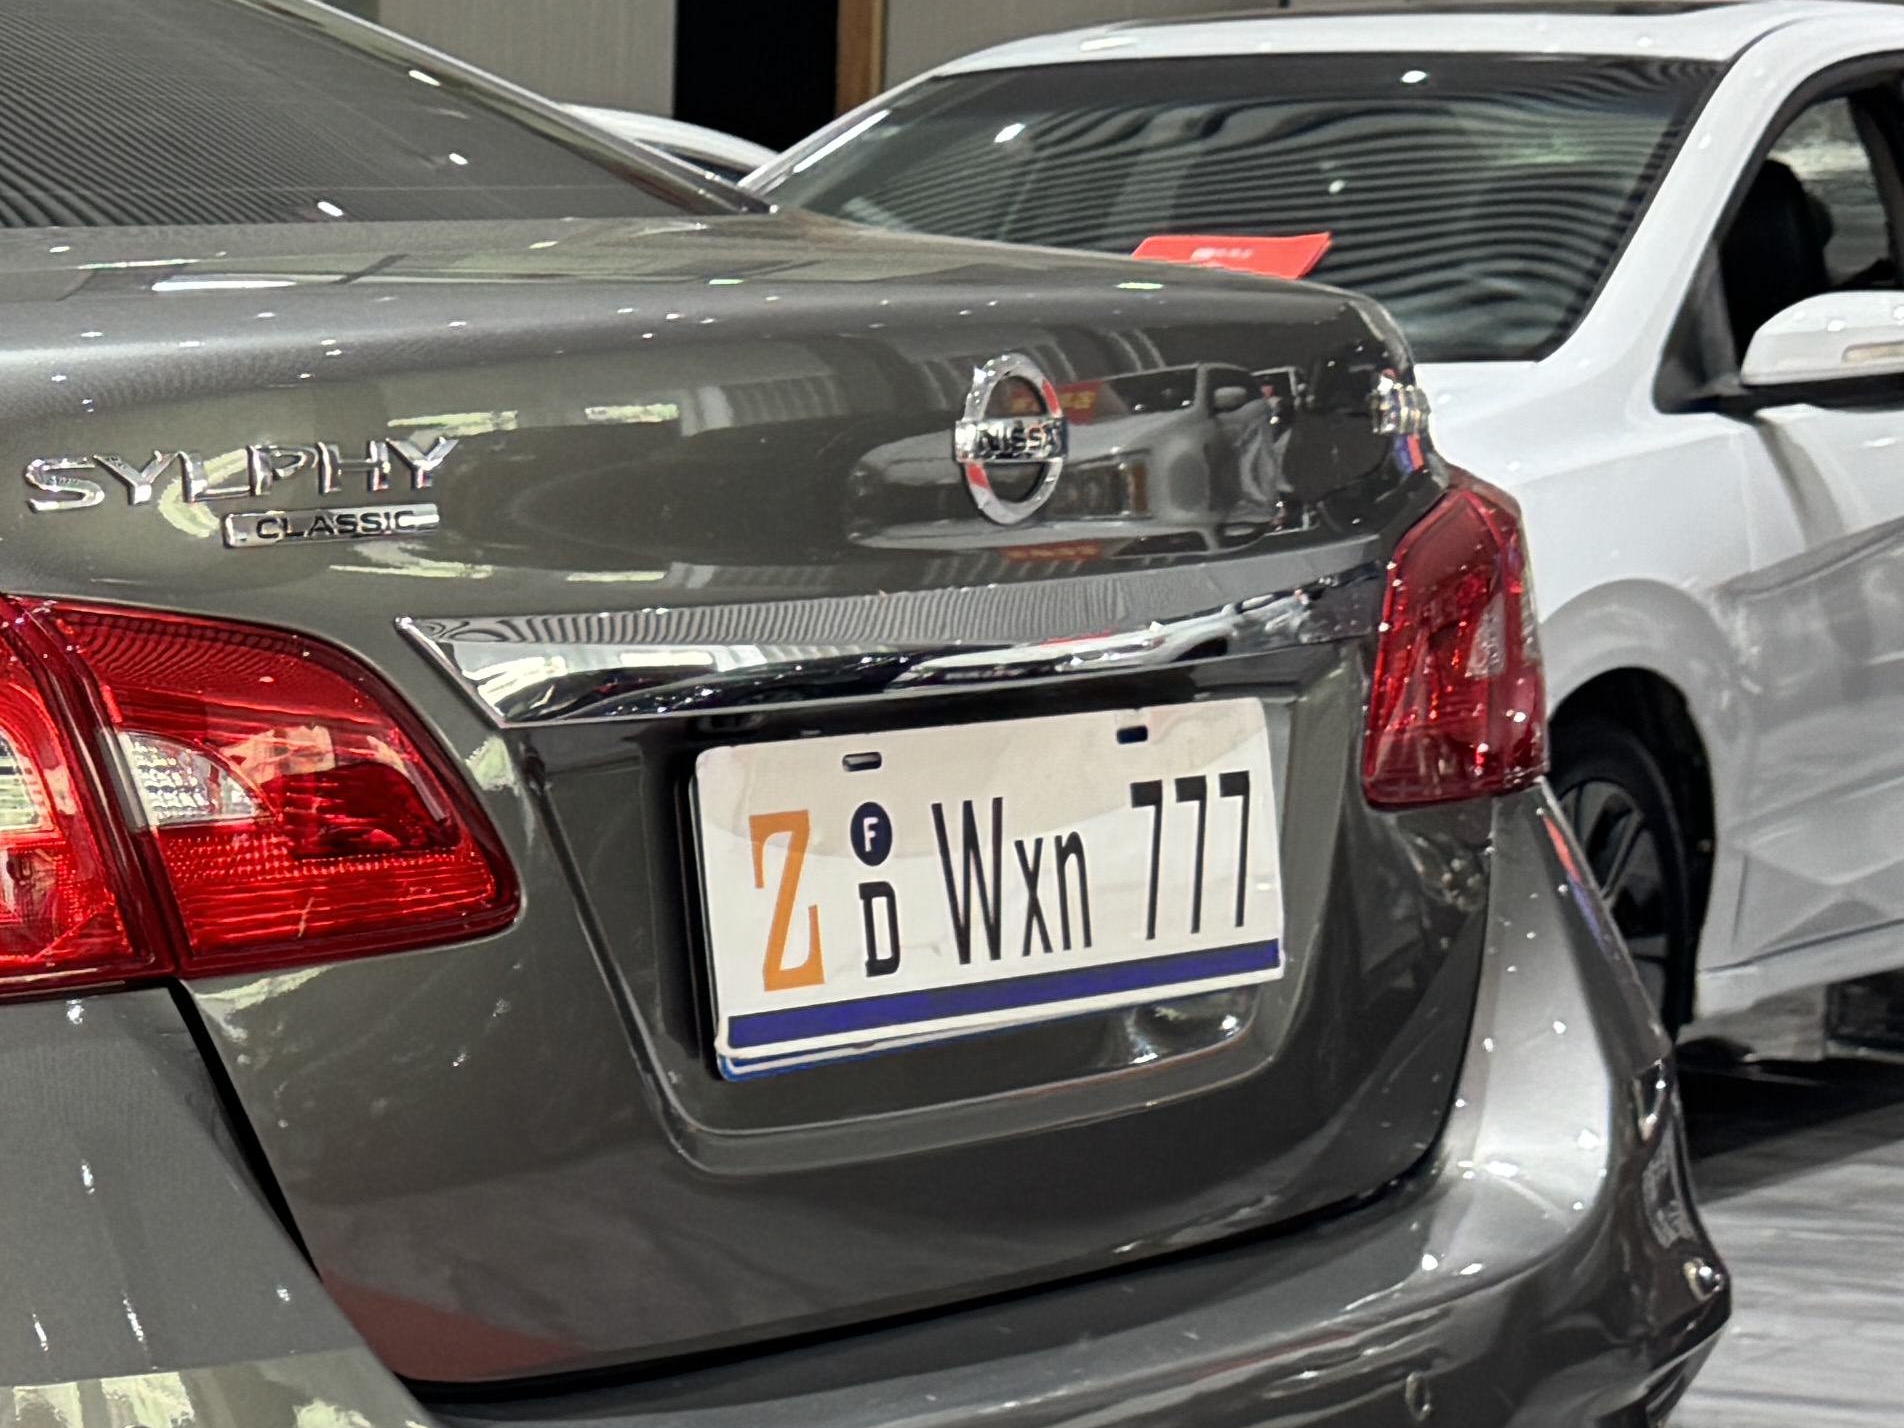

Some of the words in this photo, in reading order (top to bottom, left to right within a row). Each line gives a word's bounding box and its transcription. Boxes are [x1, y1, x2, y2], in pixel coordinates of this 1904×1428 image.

[24, 436, 460, 514] SYLPHY
[255, 509, 418, 541] CLASSIC
[748, 809, 825, 992] Z
[858, 880, 901, 978] D
[930, 796, 1092, 966] Wxn
[1129, 770, 1251, 941] 777
